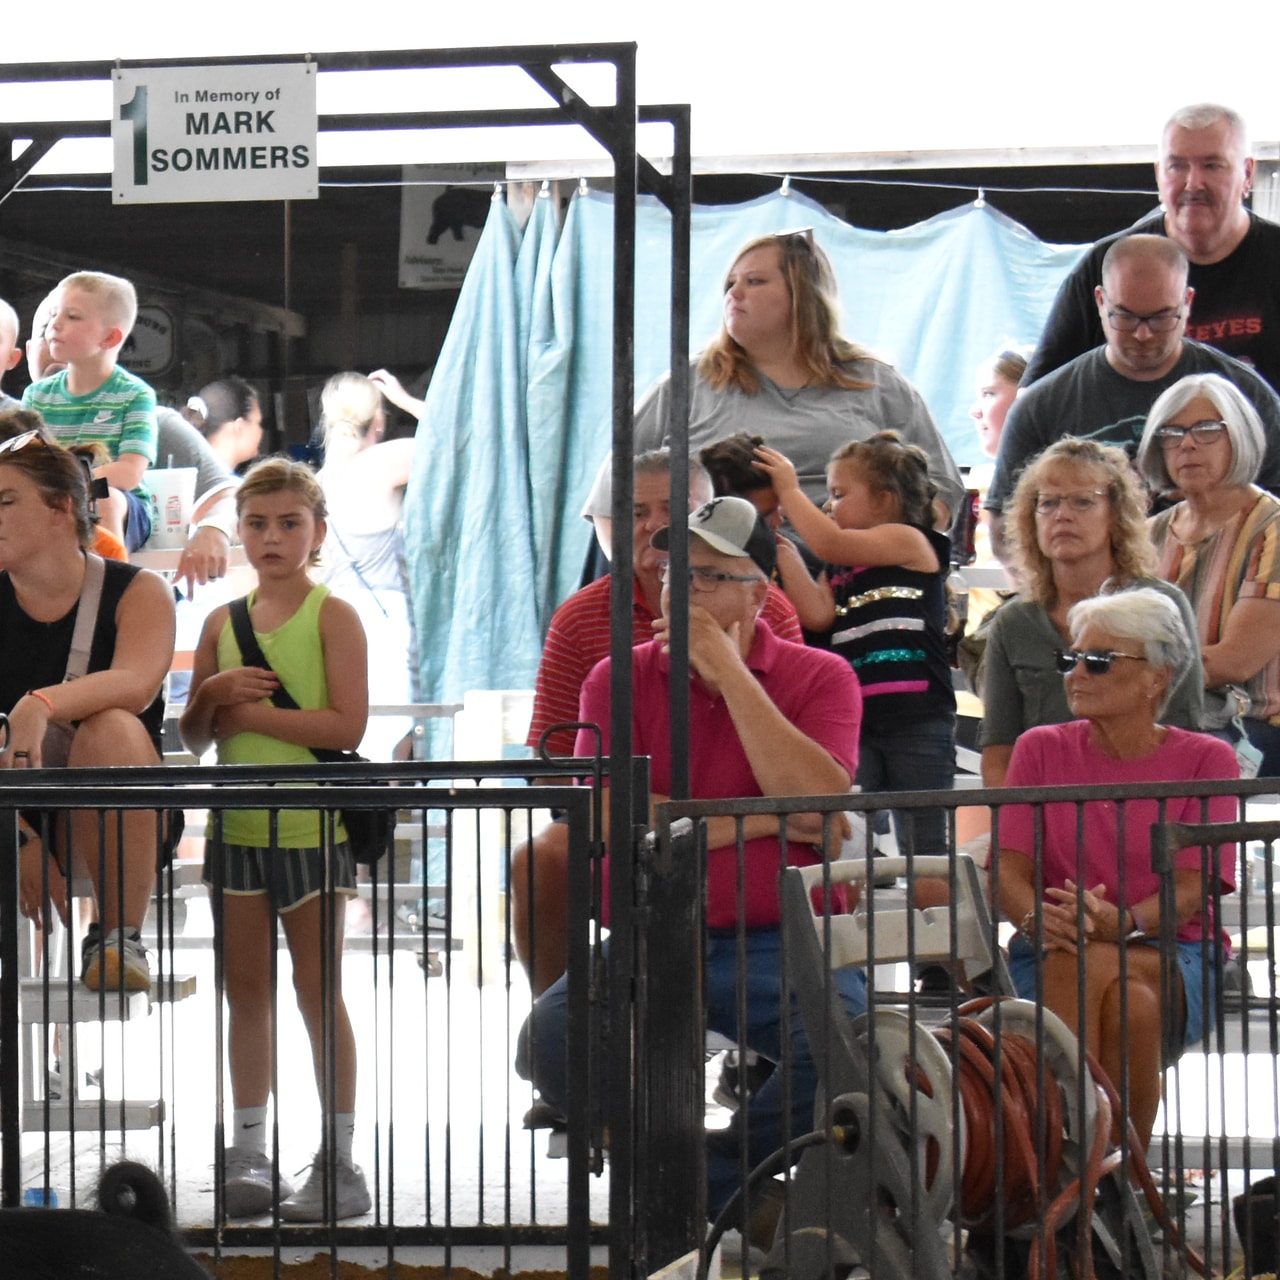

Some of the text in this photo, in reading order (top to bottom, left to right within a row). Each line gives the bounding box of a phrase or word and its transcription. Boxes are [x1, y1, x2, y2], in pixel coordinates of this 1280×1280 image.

[175, 88, 281, 105] In Memory of
[120, 85, 148, 185] 1
[186, 110, 275, 135] MARK
[151, 145, 310, 172] SOMMERS
